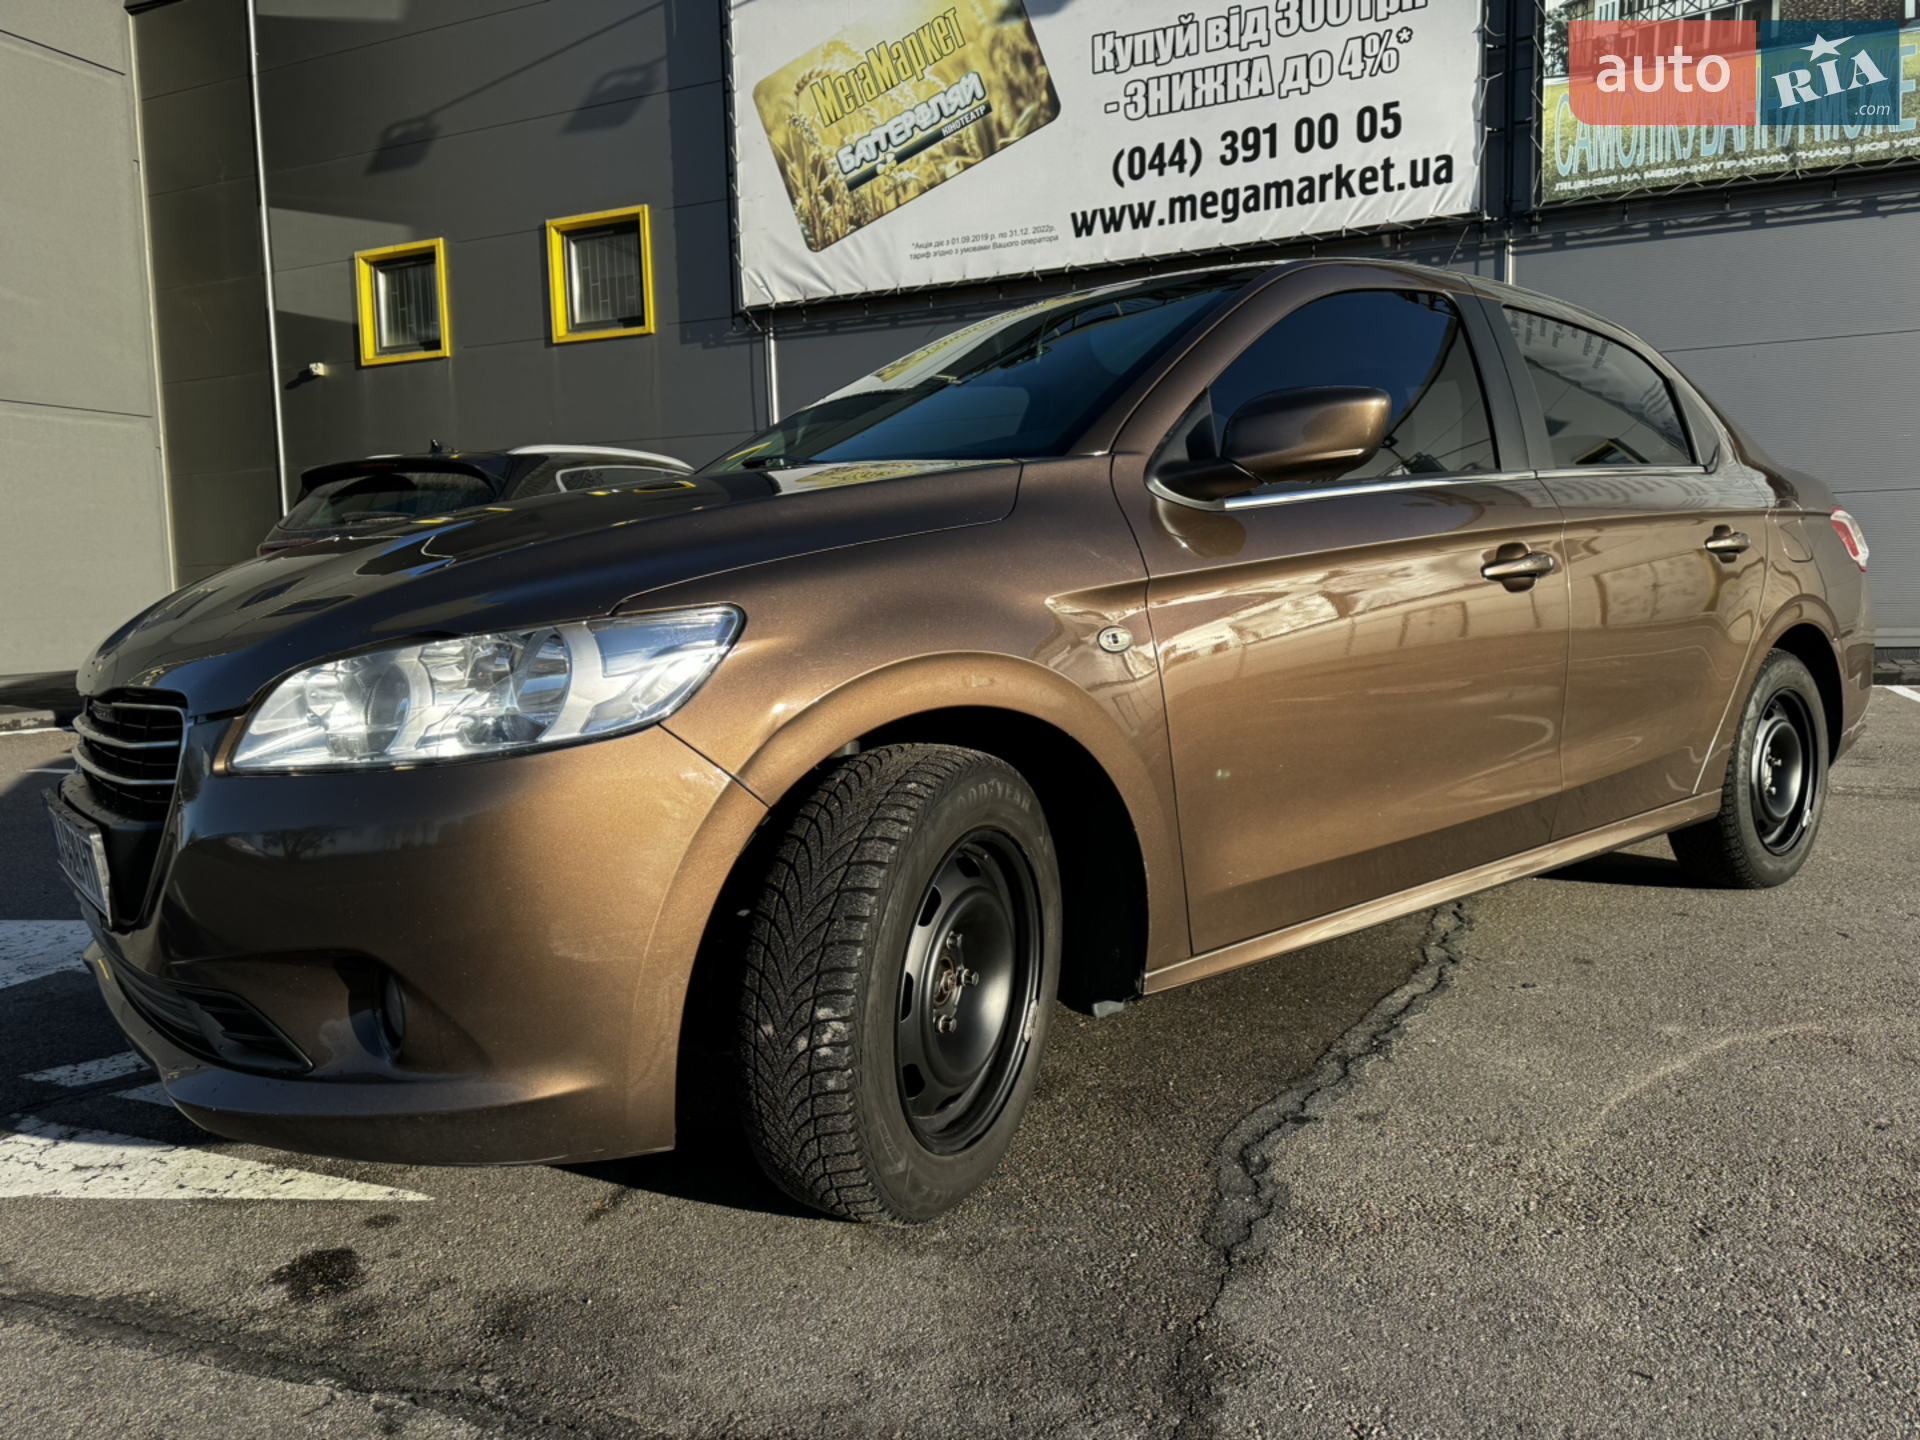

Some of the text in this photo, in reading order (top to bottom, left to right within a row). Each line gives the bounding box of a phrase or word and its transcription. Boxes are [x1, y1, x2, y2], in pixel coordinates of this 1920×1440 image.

[810, 7, 966, 128] МегаМаркет
[1092, 13, 1199, 74] Купуй
[1205, 5, 1270, 53] від
[1275, 0, 1352, 38] 300
[942, 105, 986, 137] КІНОТЕАТР
[1124, 55, 1274, 121] ЗНИЖКА
[1279, 50, 1334, 99] до
[837, 71, 986, 175] БАТТЕРФЛЯЙ
[1112, 100, 1402, 188] (044) 391 00 05
[1070, 153, 1454, 238] www.megamarket.ua
[1621, 173, 1641, 182] НА
[1643, 162, 1714, 180] МЕДИЧНУ
[1716, 153, 1794, 170] ПРАКТИКУ
[951, 233, 990, 246] 01.09.2019
